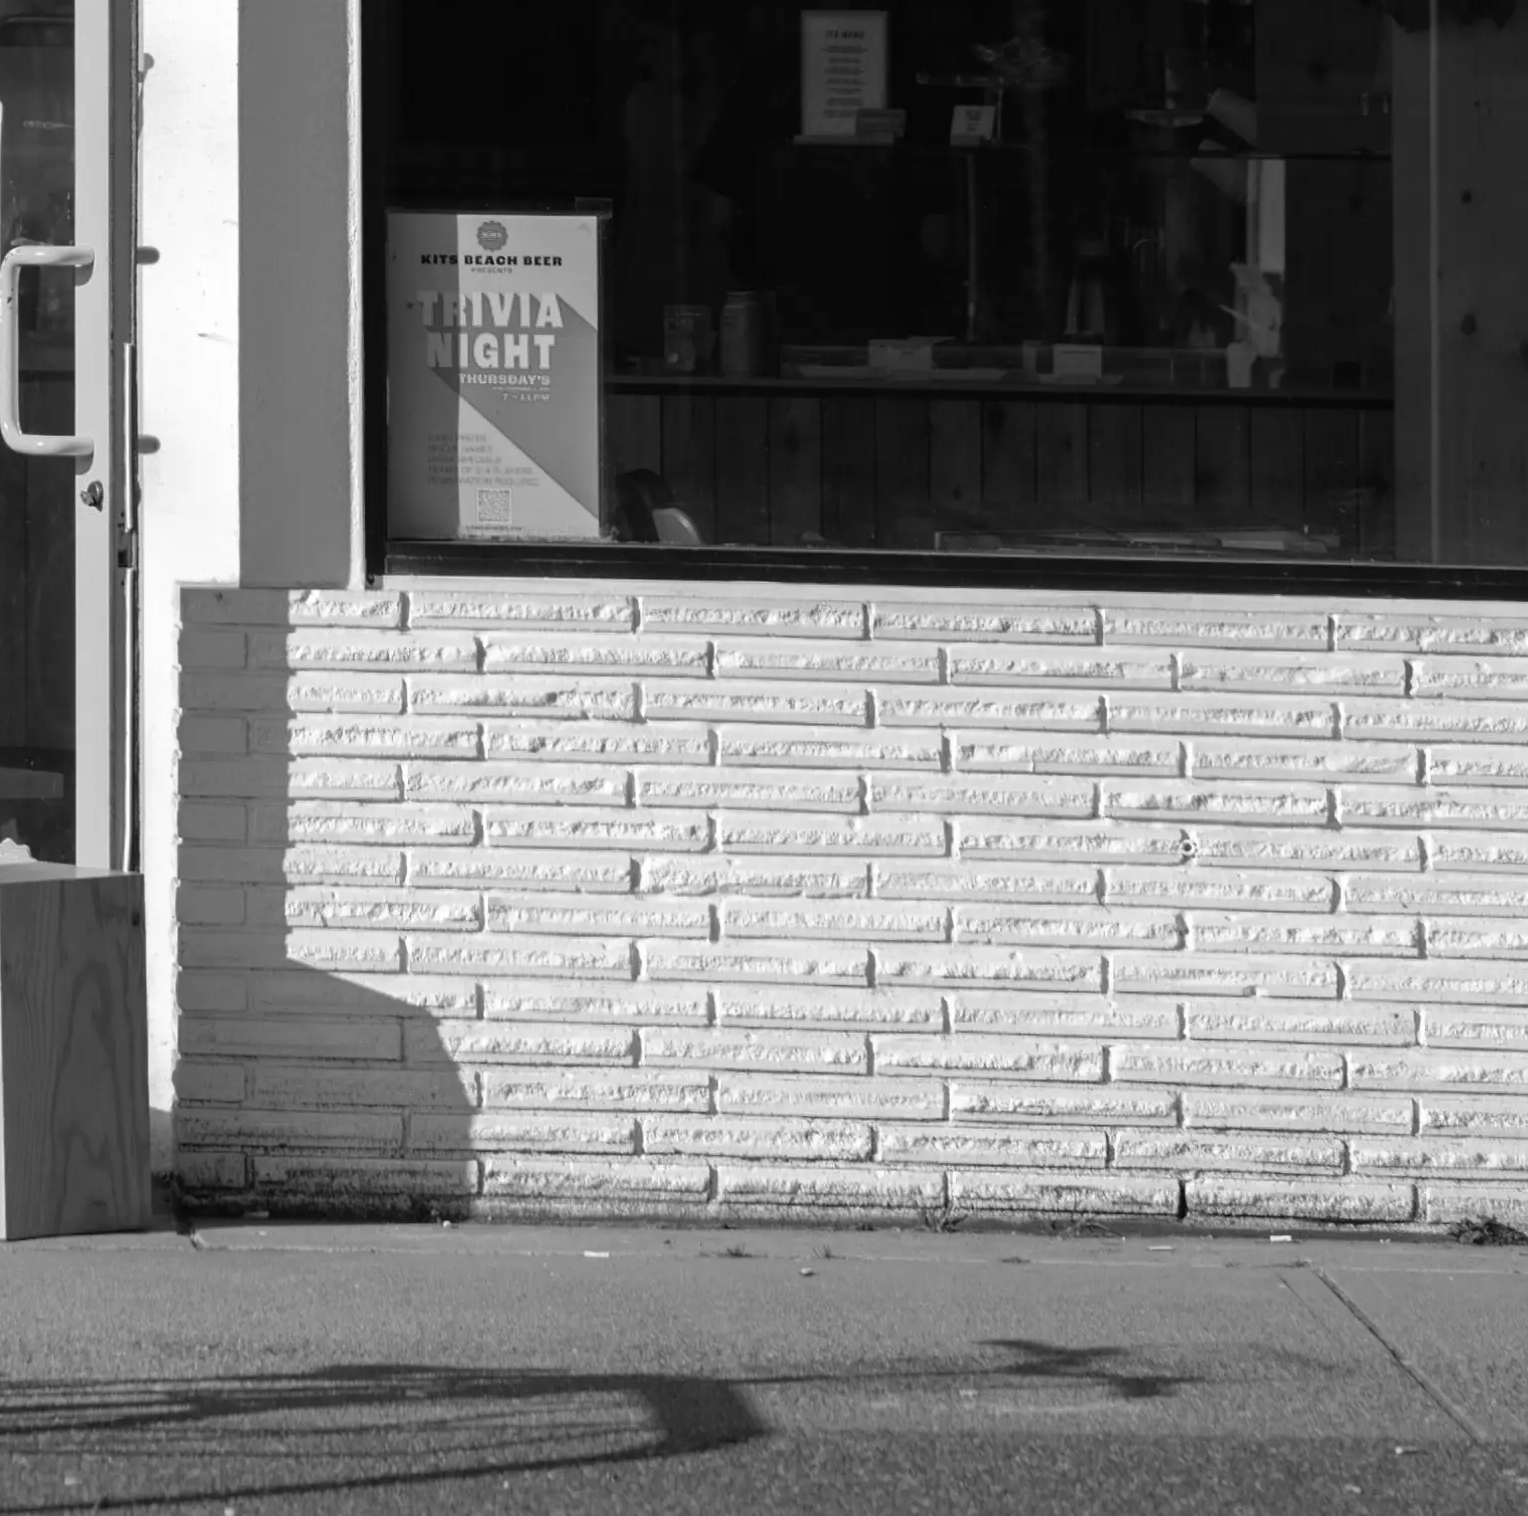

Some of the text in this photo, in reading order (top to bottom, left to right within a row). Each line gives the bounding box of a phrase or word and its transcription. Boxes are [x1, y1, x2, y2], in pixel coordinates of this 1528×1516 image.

[420, 253, 563, 267] KITS BEACH BEER
[416, 290, 564, 329] TRIVIA
[427, 332, 556, 370] NIGHT
[458, 373, 551, 386] THURSDAY'S
